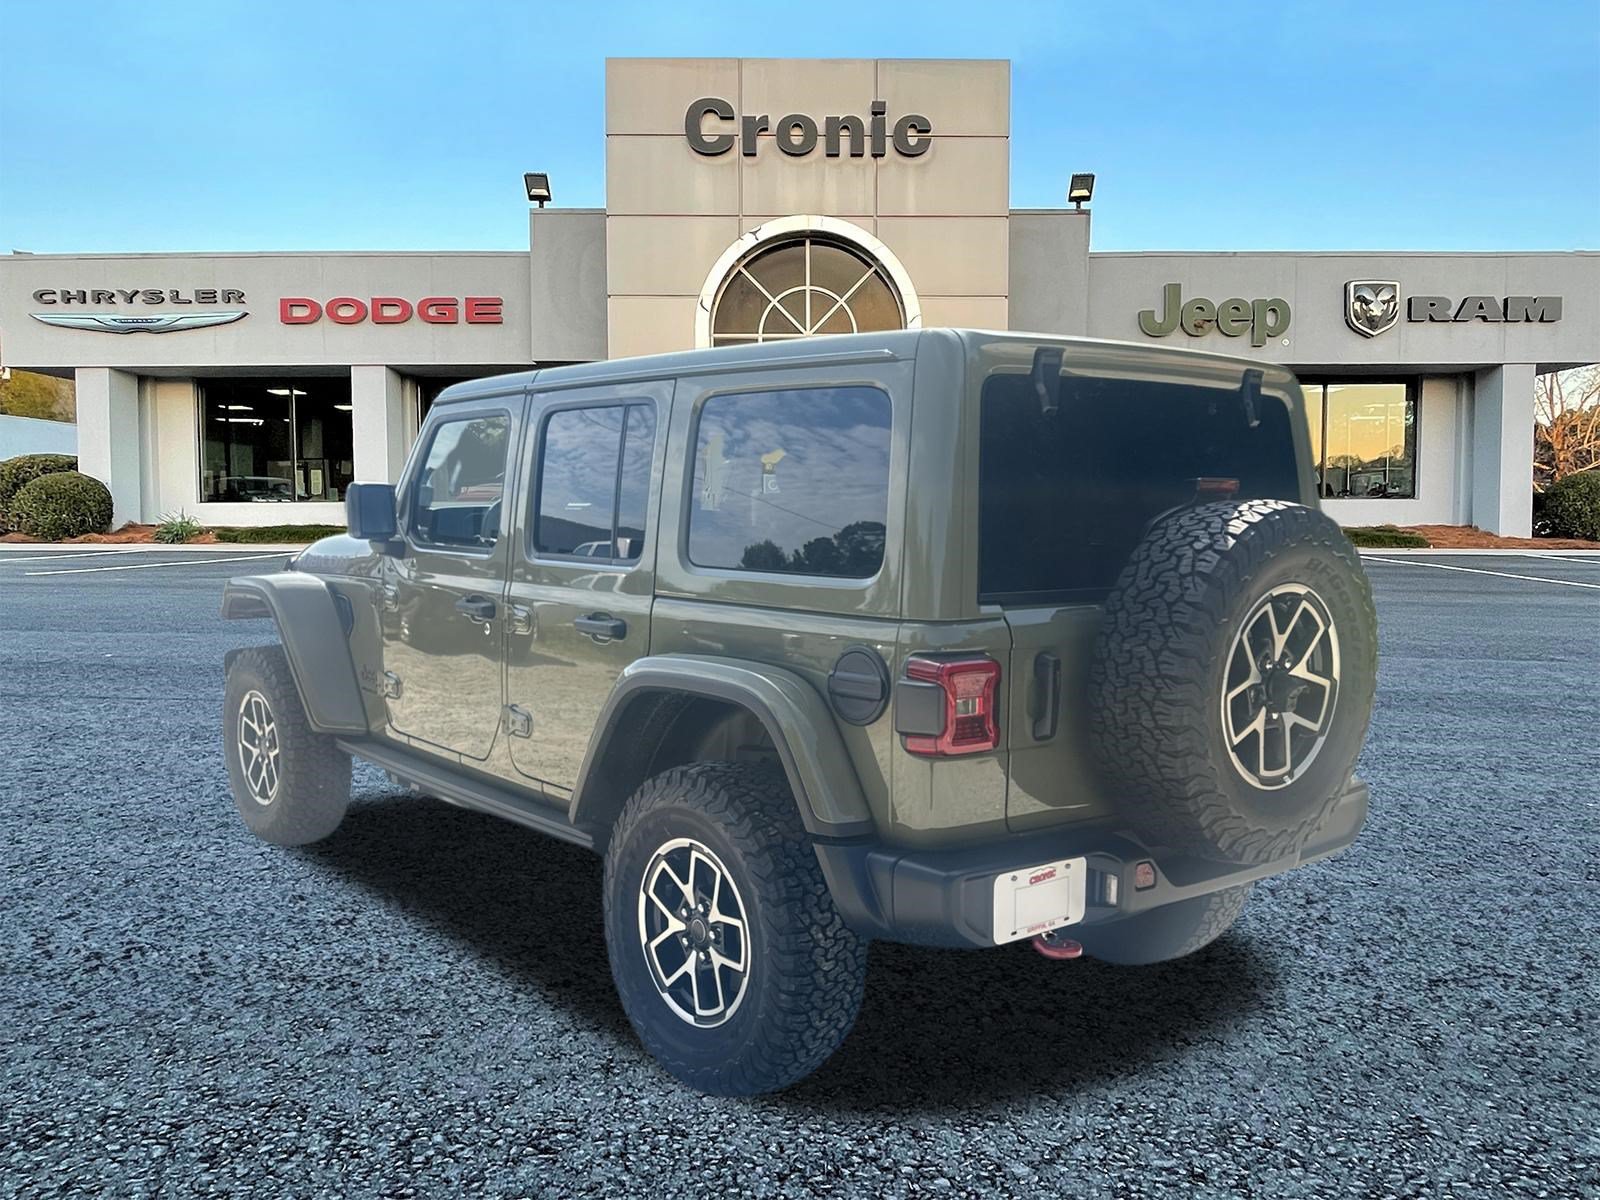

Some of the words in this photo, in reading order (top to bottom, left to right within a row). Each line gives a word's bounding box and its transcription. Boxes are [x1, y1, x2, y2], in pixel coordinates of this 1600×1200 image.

[685, 97, 932, 157] Cronic
[32, 289, 246, 304] CHRYSLER
[1407, 296, 1563, 322] RAM
[279, 297, 503, 324] DODGE
[1138, 283, 1291, 347] Jeep
